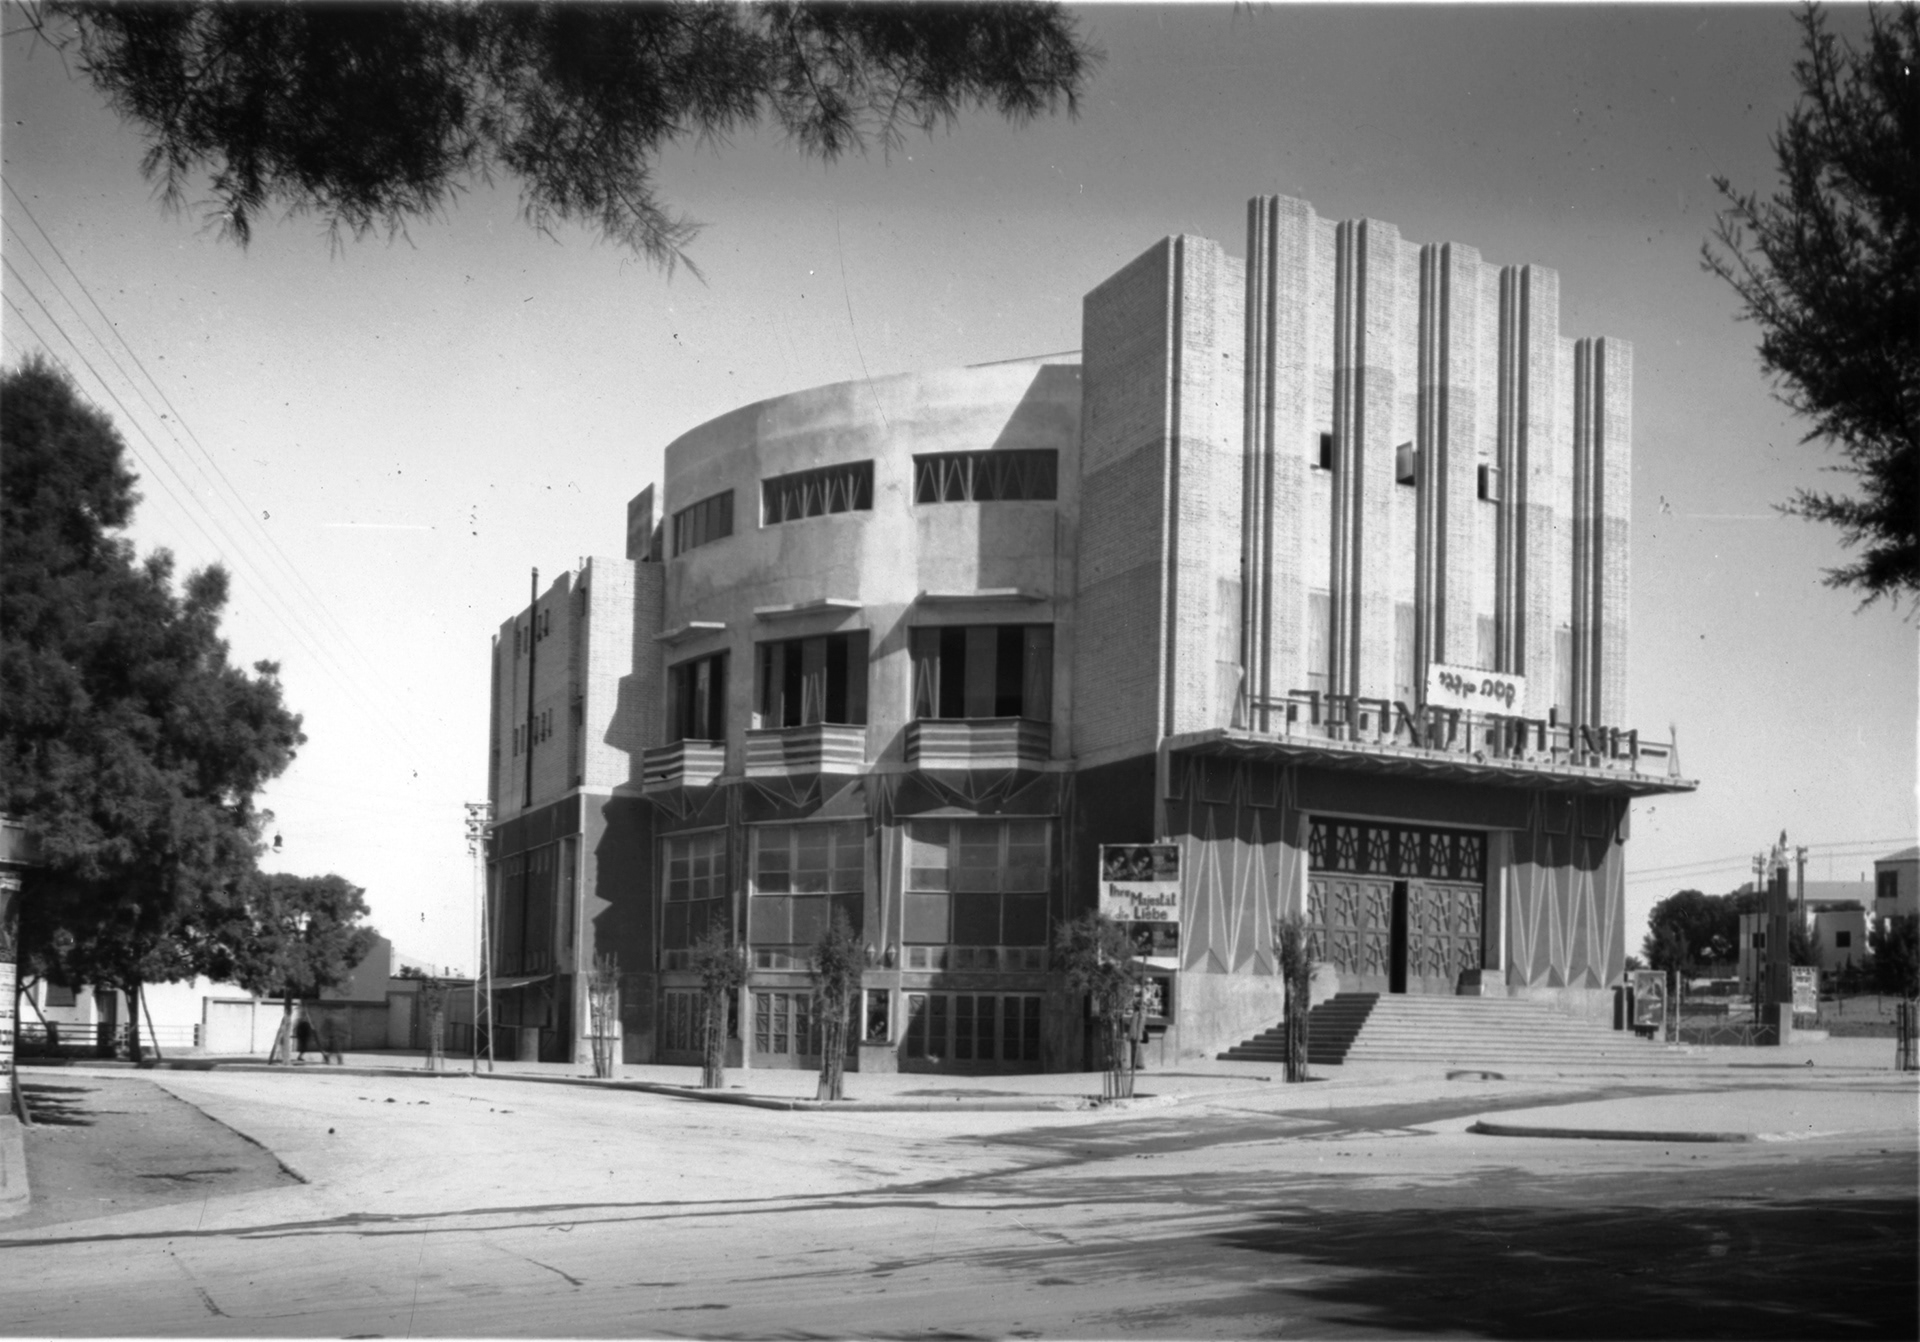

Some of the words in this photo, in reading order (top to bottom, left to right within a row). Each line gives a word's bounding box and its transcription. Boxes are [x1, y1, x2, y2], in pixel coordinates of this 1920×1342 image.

[1109, 883, 1131, 898] Ihre
[1130, 892, 1176, 910] Majestät
[1115, 905, 1129, 919] die
[1134, 906, 1168, 919] Liebe
